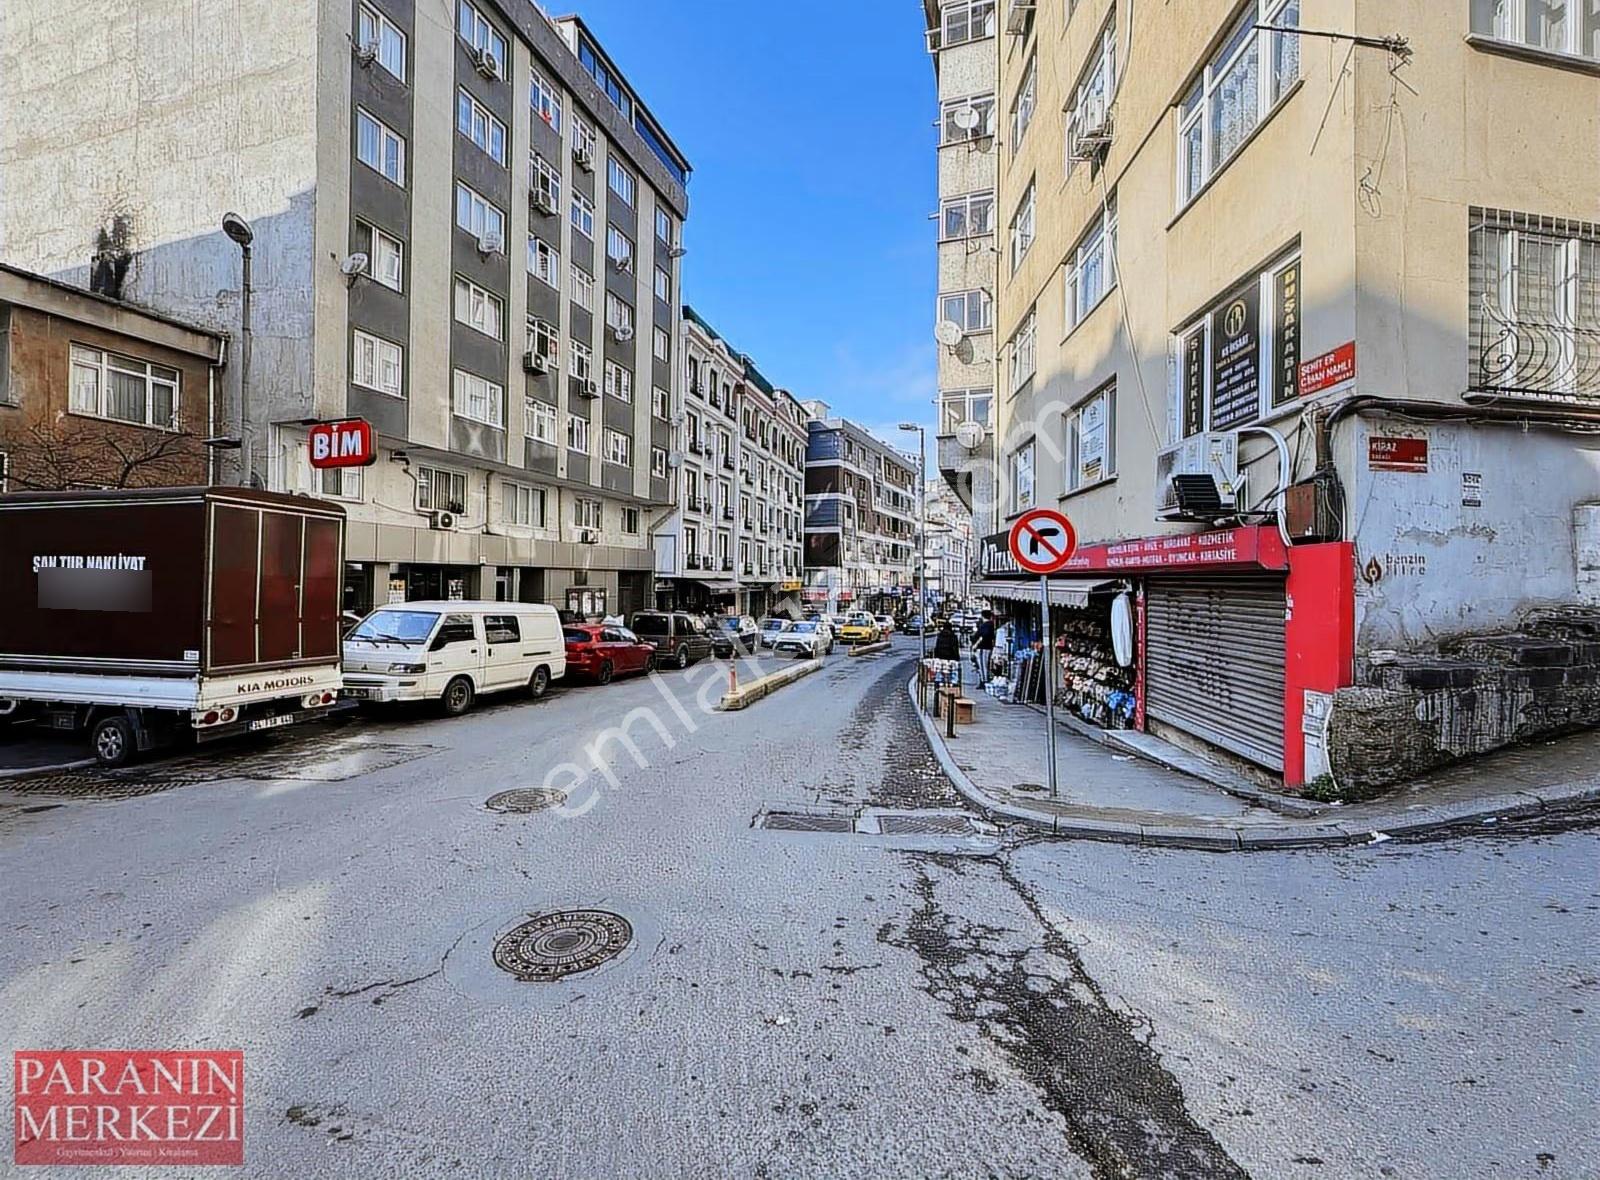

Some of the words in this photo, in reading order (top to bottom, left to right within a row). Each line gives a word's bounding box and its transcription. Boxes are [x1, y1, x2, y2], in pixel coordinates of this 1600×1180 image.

[313, 425, 362, 460] BİM
[1385, 552, 1426, 565] benzin
[237, 682, 260, 694] KIA
[264, 676, 314, 691] MOTORS
